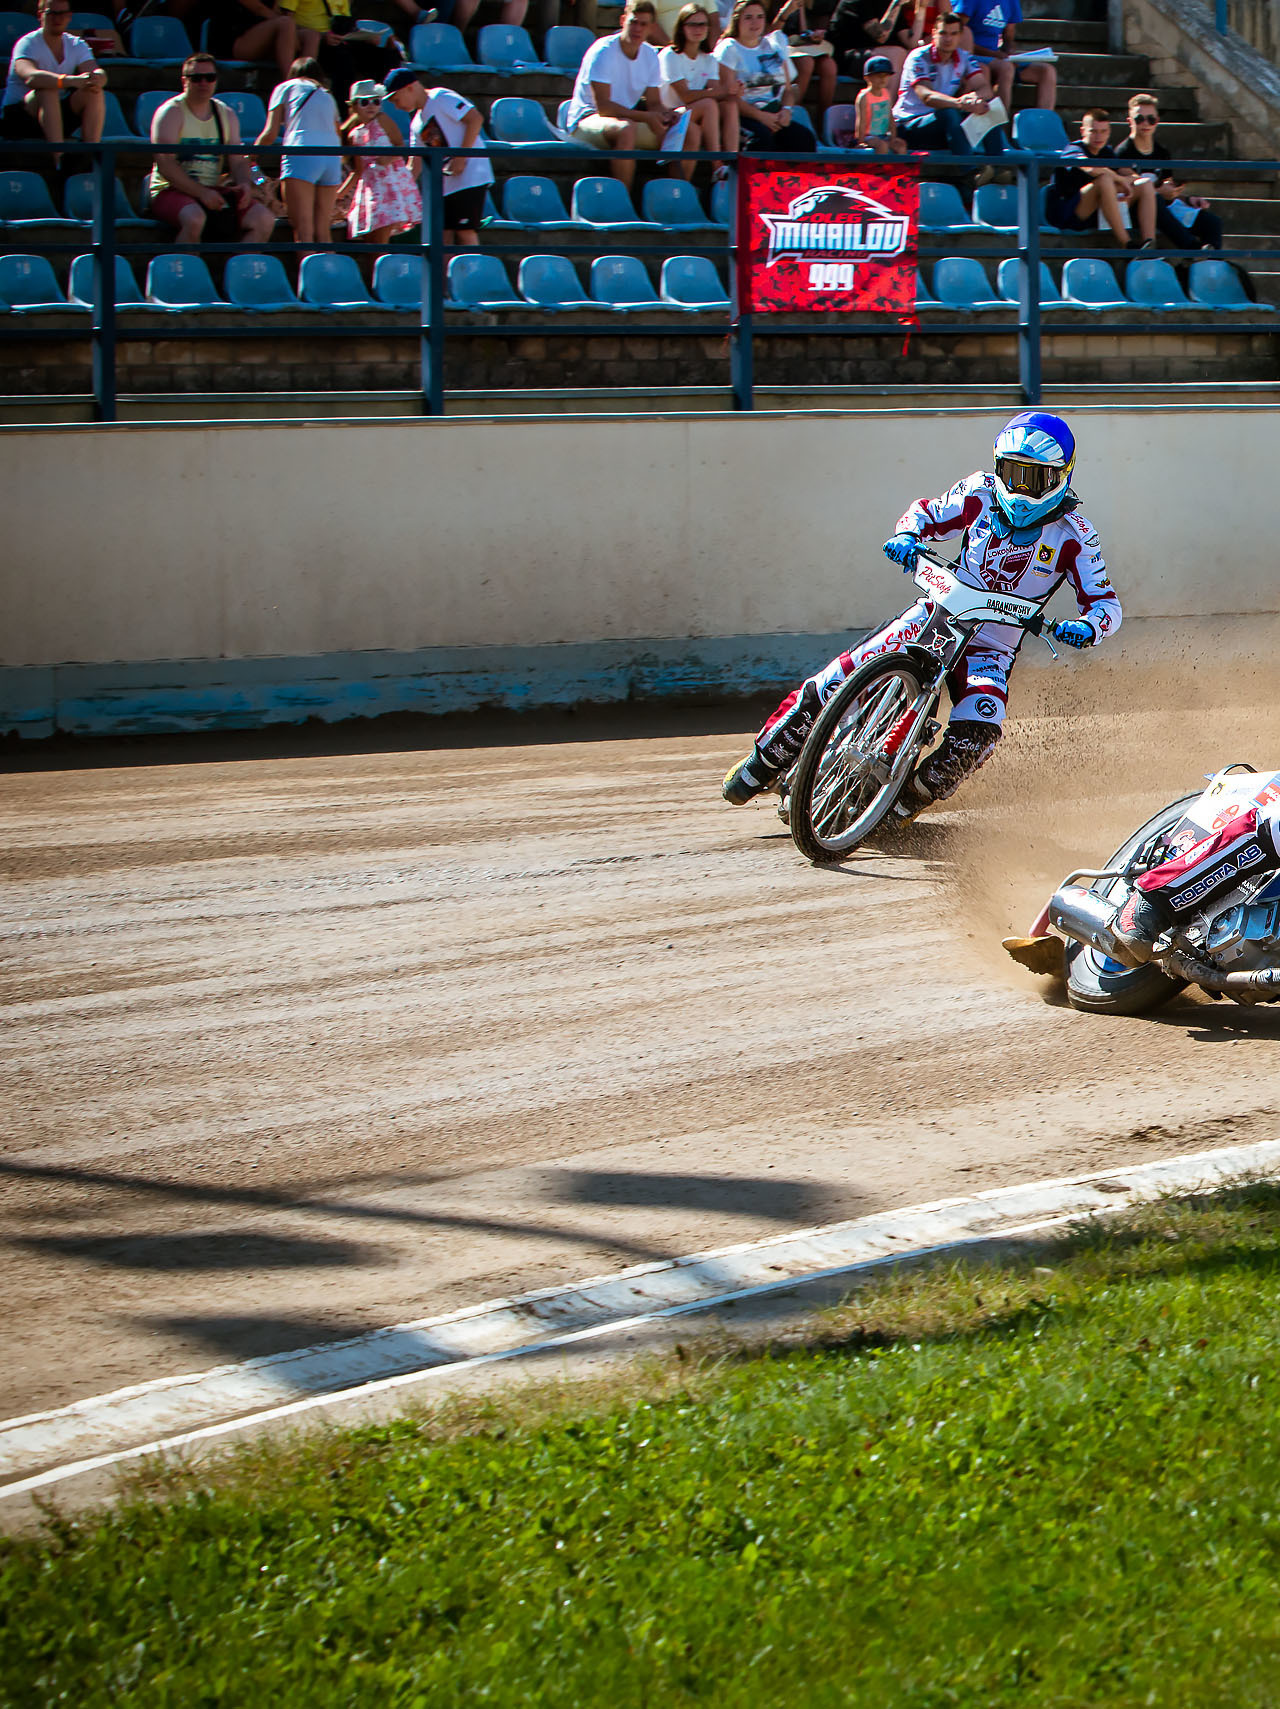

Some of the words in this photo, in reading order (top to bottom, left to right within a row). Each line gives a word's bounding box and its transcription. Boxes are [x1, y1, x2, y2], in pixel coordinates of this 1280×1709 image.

[809, 212, 863, 223] OLEG
[774, 222, 903, 251] MIHAILOV
[803, 250, 869, 258] RACING
[808, 263, 855, 291] 999
[1169, 863, 1238, 909] ROBOTA
[1236, 843, 1264, 869] AB
